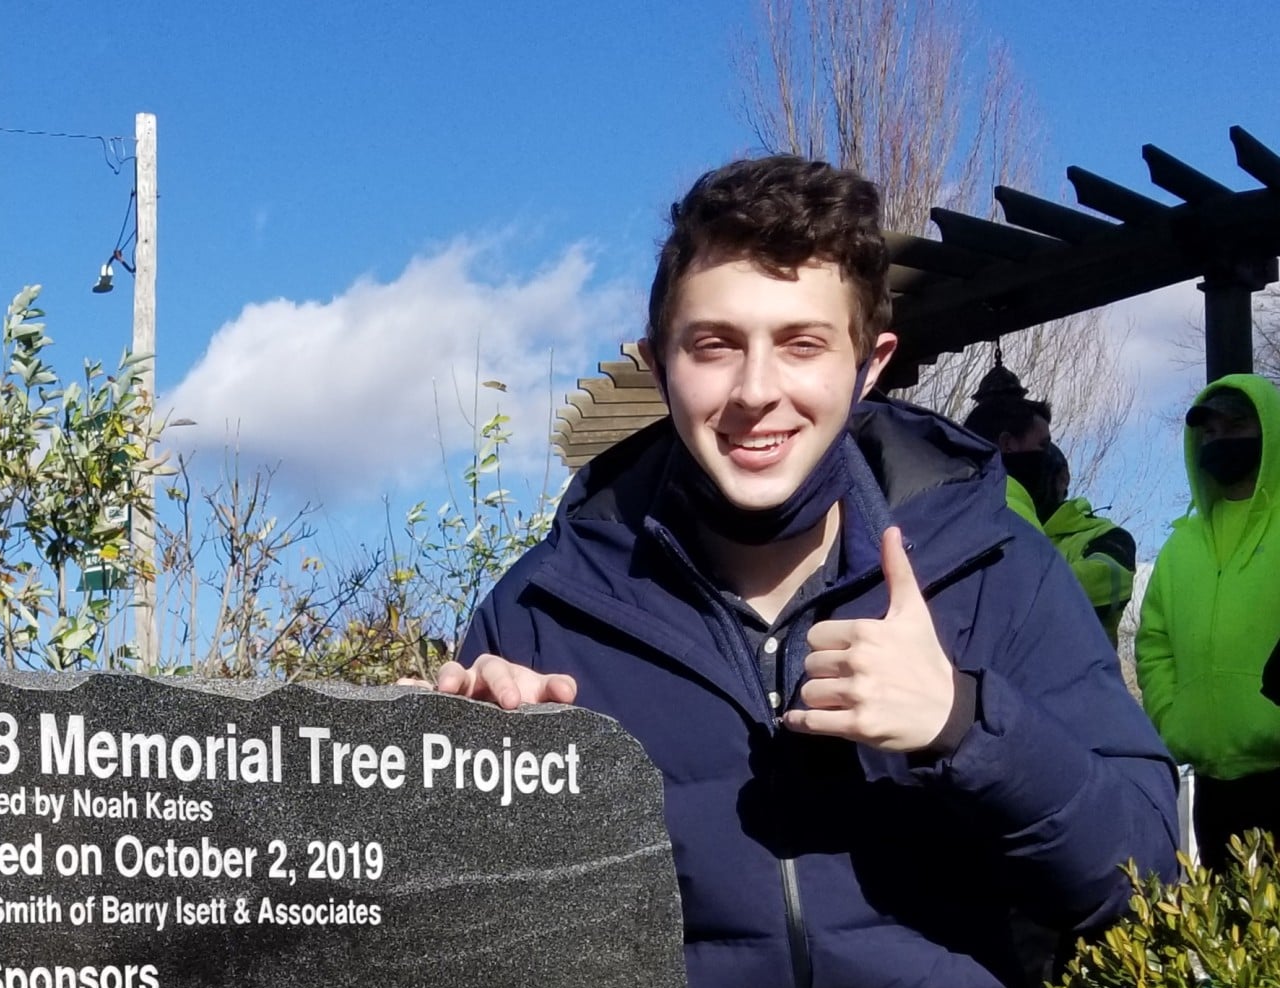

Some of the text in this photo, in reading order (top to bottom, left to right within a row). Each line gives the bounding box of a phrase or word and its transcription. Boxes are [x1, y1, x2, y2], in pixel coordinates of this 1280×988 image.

[40, 713, 282, 783] Memorial
[299, 727, 405, 789] Tree
[423, 733, 580, 806] Project
[35, 790, 64, 823] by
[74, 789, 137, 818] Noah
[146, 792, 212, 821] Kates
[56, 844, 102, 876] on
[115, 835, 257, 878] October
[268, 839, 296, 885] 2,
[308, 841, 383, 880] 2019
[70, 896, 95, 925] of
[103, 896, 168, 931] Barry
[177, 897, 226, 925] Isett
[234, 898, 250, 924] &
[258, 897, 381, 925] Associates
